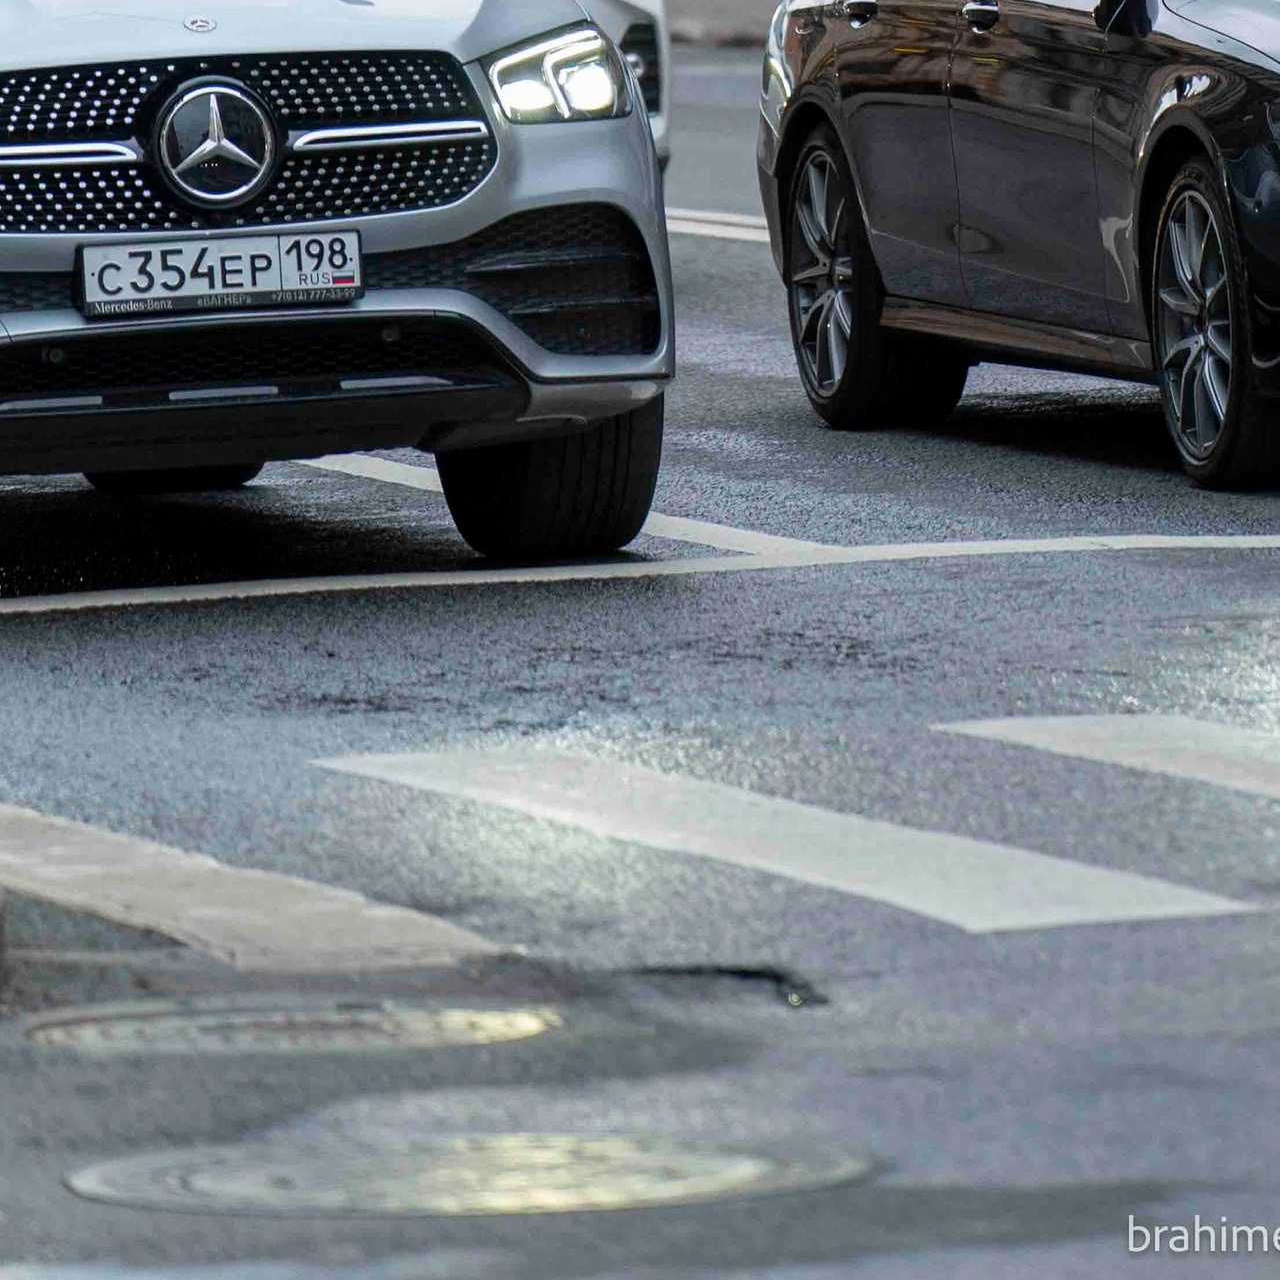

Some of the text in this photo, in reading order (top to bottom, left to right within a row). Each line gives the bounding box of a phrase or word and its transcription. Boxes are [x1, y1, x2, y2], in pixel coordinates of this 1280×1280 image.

[285, 238, 347, 272] 198
[299, 271, 331, 286] RUS
[95, 298, 173, 314] Mercedes-Benz
